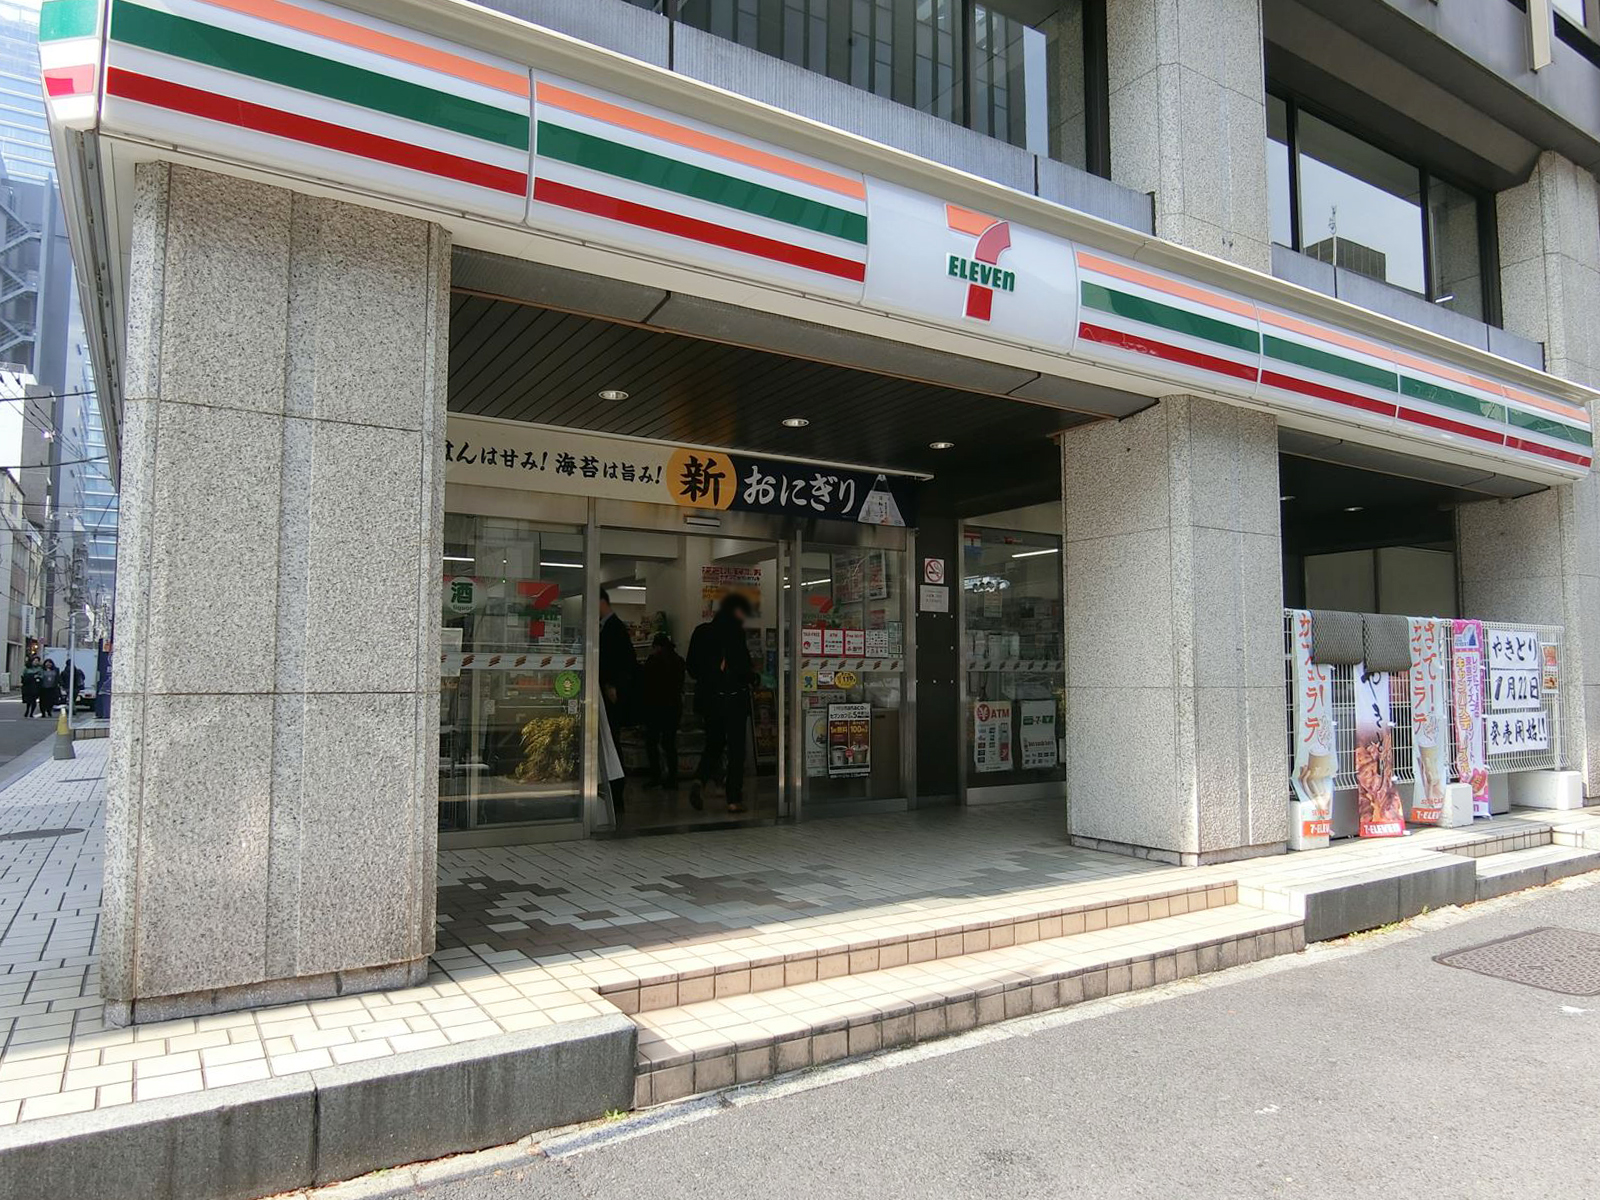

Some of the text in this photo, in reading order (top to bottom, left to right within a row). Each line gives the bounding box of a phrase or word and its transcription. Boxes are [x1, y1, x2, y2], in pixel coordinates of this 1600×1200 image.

[554, 452, 664, 485] 海苔は旨み!
[680, 455, 726, 507] 新
[743, 465, 856, 514] おにぎり
[451, 581, 473, 604] 酒
[452, 604, 473, 612] liquor
[1492, 635, 1537, 661] やきとり
[1494, 676, 1539, 701] 1月22日
[991, 708, 1010, 719] ATM
